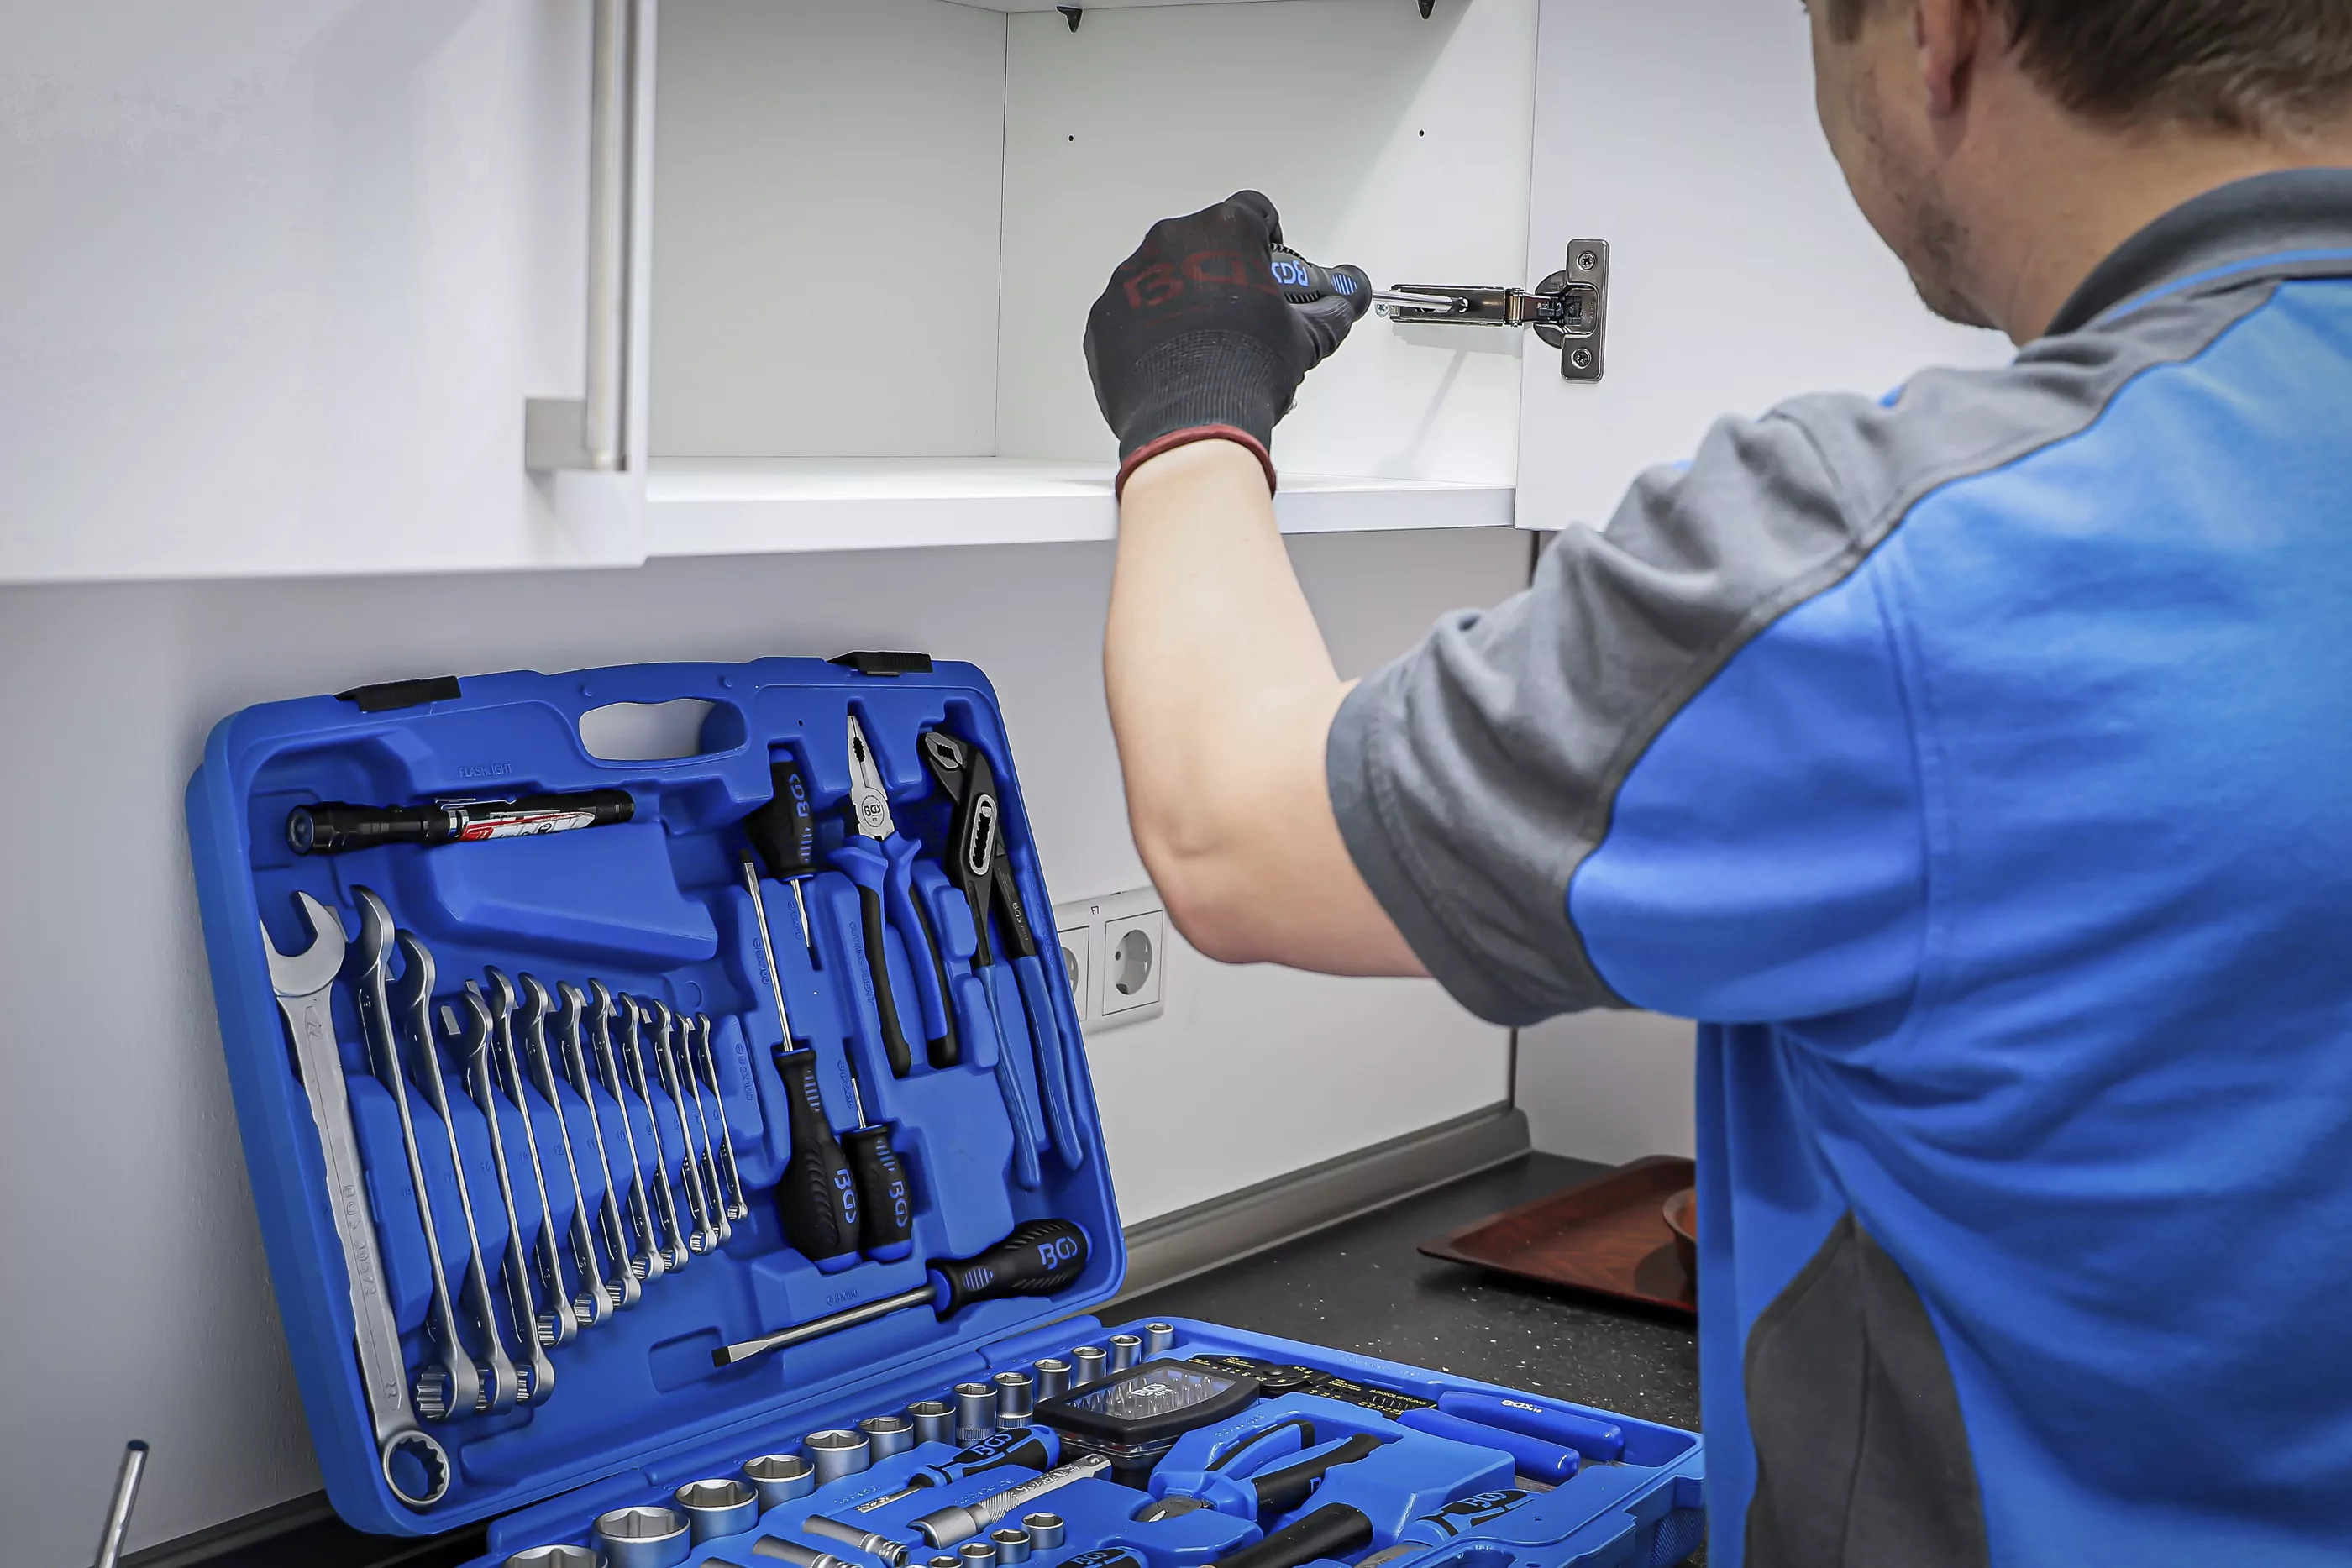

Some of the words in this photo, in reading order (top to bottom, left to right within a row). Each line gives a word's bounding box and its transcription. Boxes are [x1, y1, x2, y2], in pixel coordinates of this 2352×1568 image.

[1270, 260, 1310, 286] BGS
[459, 763, 512, 779] FLASHLIGHT
[788, 773, 810, 818] BGS
[863, 804, 882, 817] BGS
[1011, 901, 1024, 923] BGS
[615, 1130, 627, 1142] 10
[834, 1168, 857, 1224] BGS
[889, 1180, 908, 1227] BGS
[1037, 1236, 1078, 1270] BGS
[969, 1434, 1012, 1456] BGS
[1456, 1492, 1508, 1508] BGS
[1070, 1552, 1108, 1565] BGS
